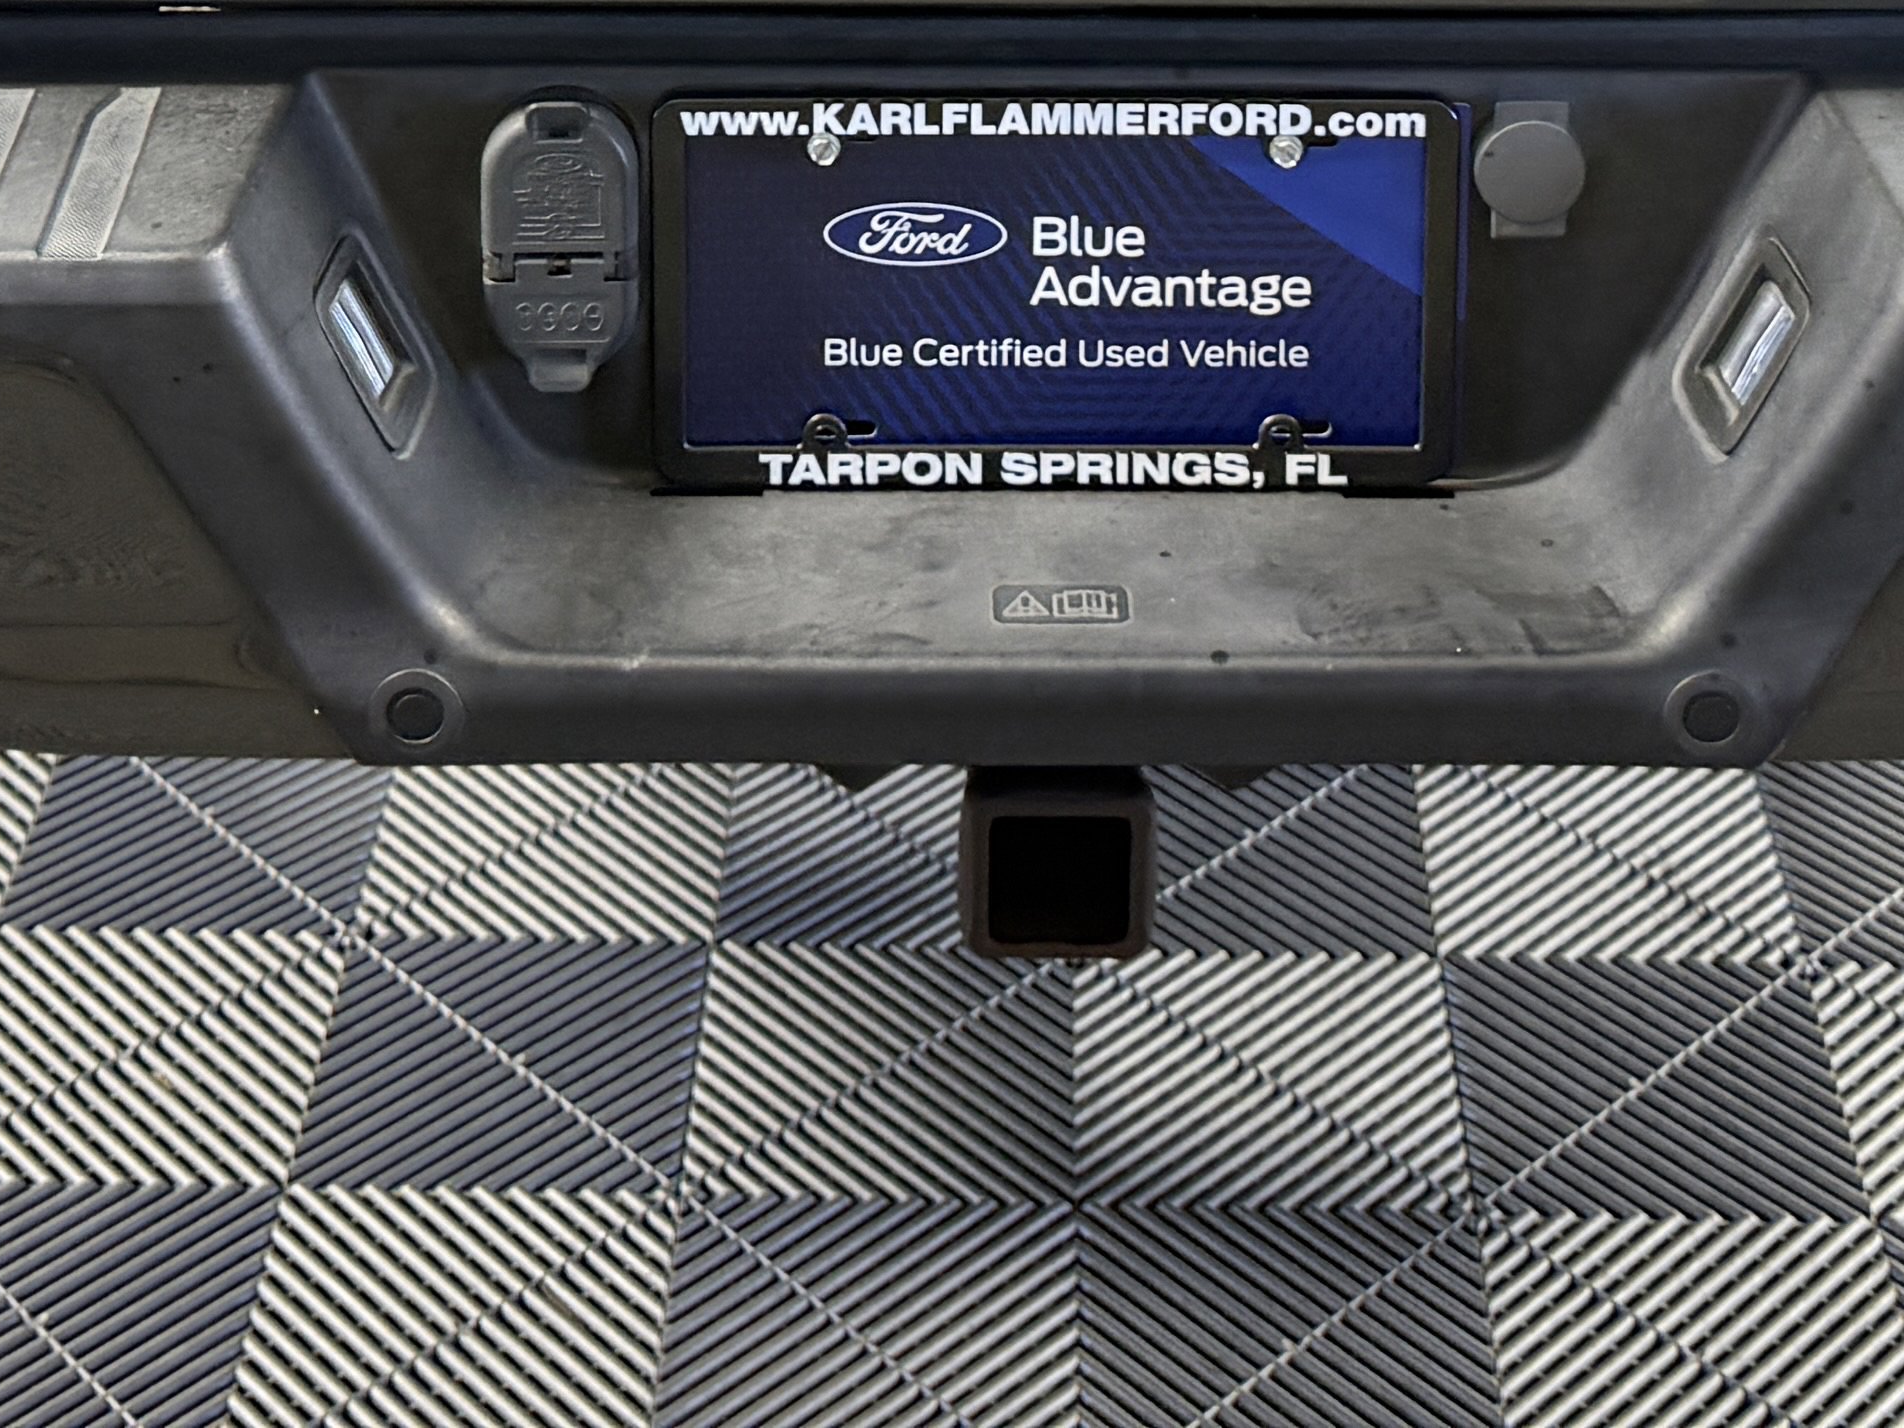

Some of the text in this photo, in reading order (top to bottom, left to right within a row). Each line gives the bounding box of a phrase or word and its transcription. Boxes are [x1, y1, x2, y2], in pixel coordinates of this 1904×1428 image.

[680, 102, 1427, 138] www.KARLFLAMMERFORD.com
[858, 210, 973, 255] Ford
[1032, 215, 1146, 257] Blue
[1030, 265, 1312, 315] Advantage
[823, 337, 1310, 368] Blue Certified Used Vehicle
[759, 452, 1349, 489] TARPON SPRINGS, FL
